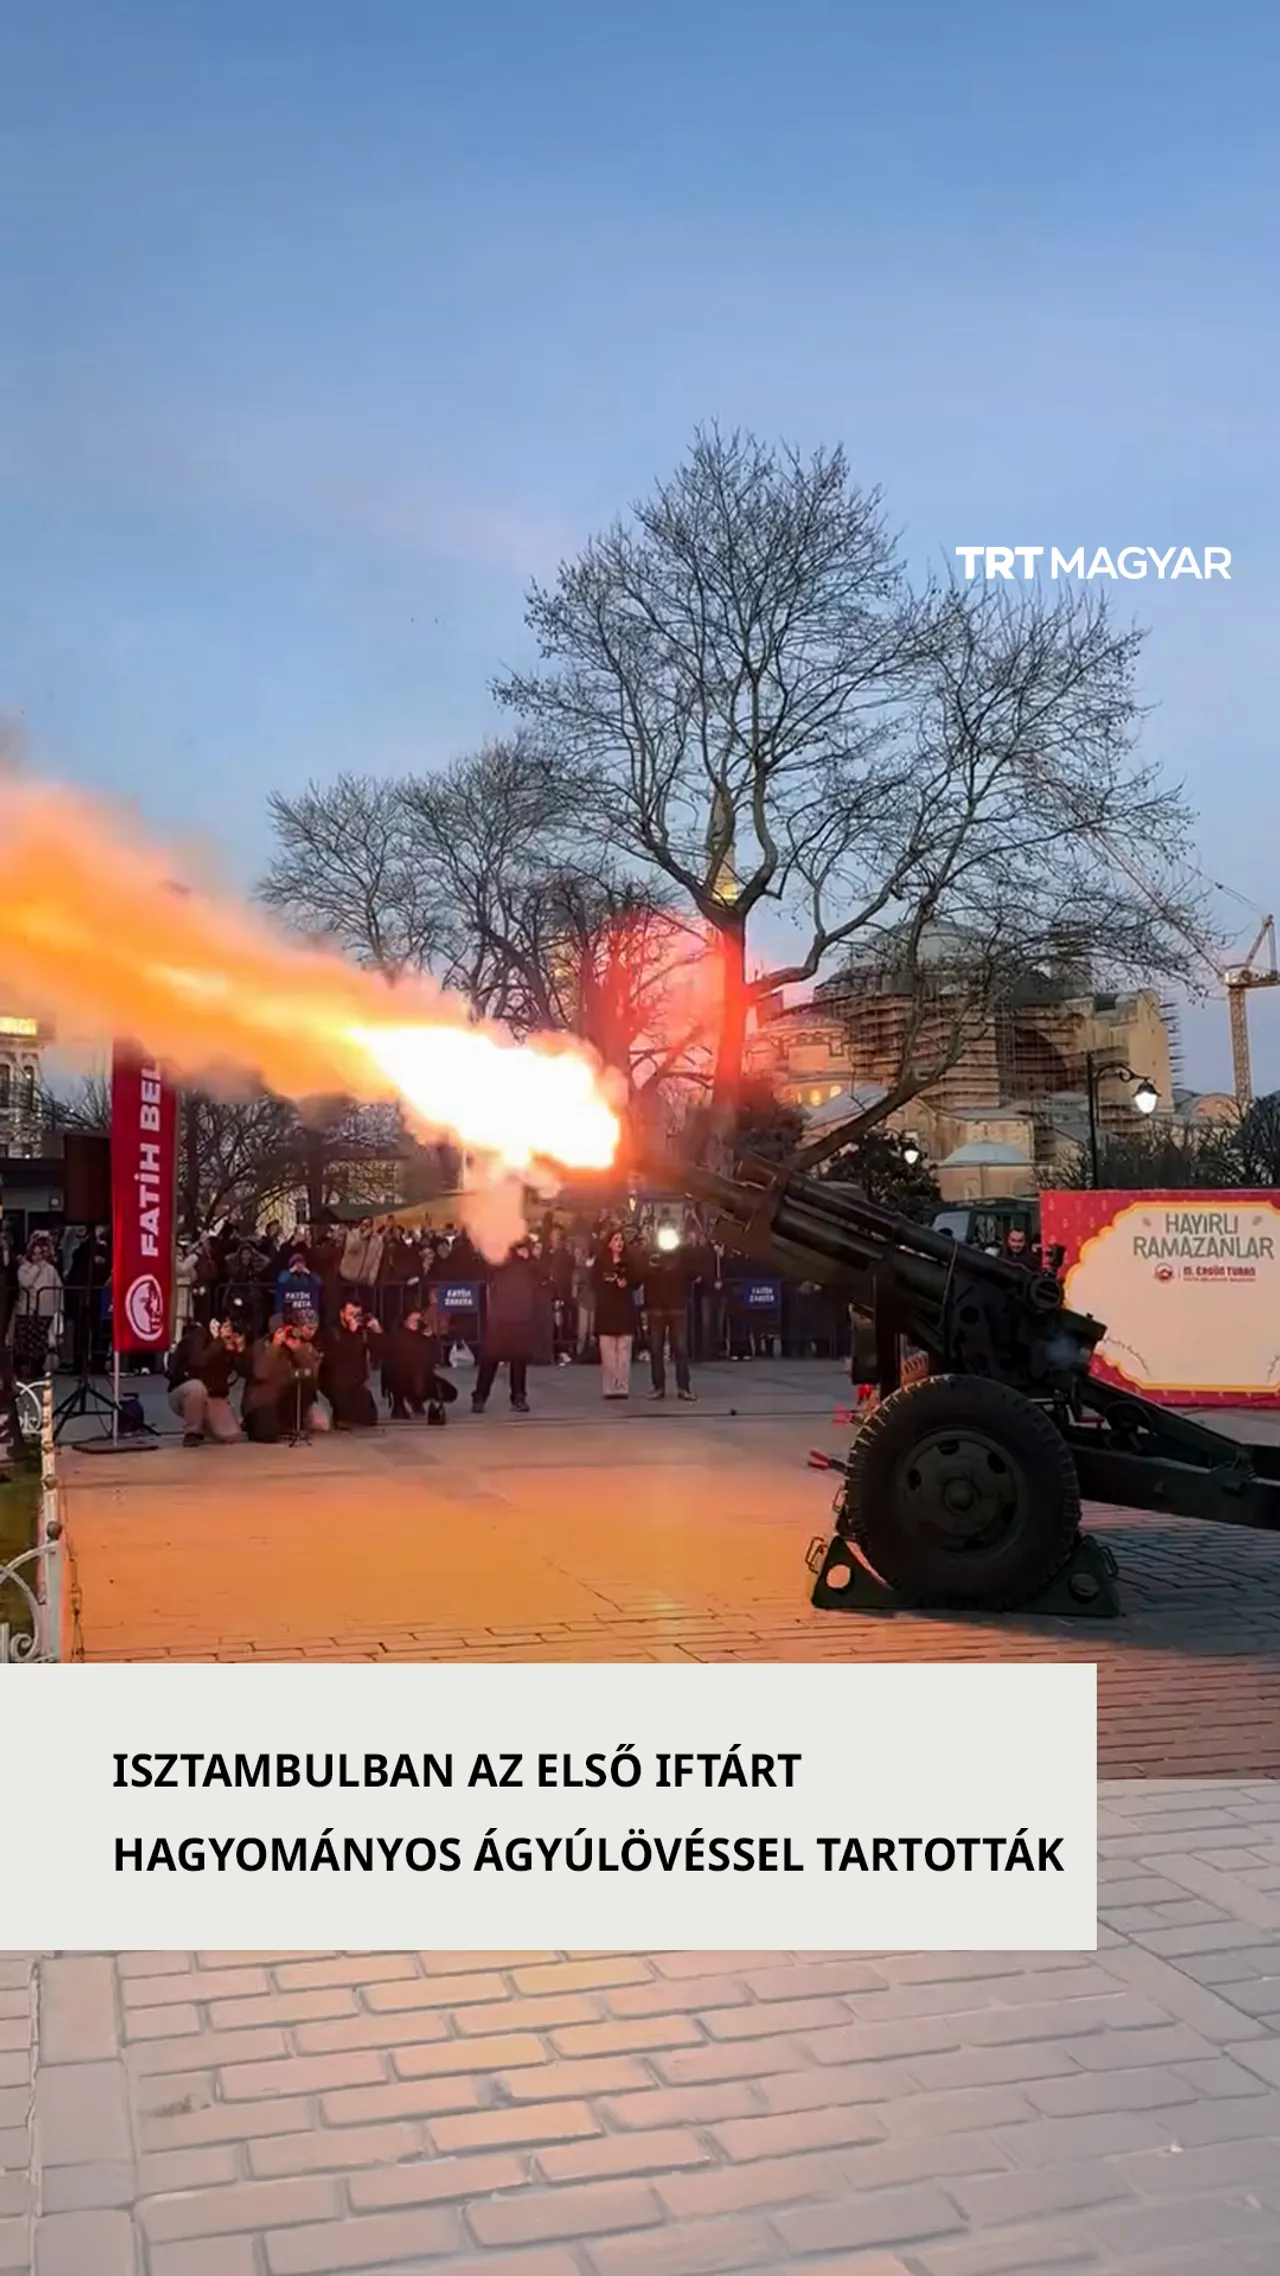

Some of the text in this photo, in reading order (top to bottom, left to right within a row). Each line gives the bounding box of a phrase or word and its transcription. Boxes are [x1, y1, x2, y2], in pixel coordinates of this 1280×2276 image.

[134, 1142, 160, 1257] FATİH
[1165, 1213, 1239, 1235] HAYIRLI
[1133, 1236, 1274, 1259] RAMAZANLAR
